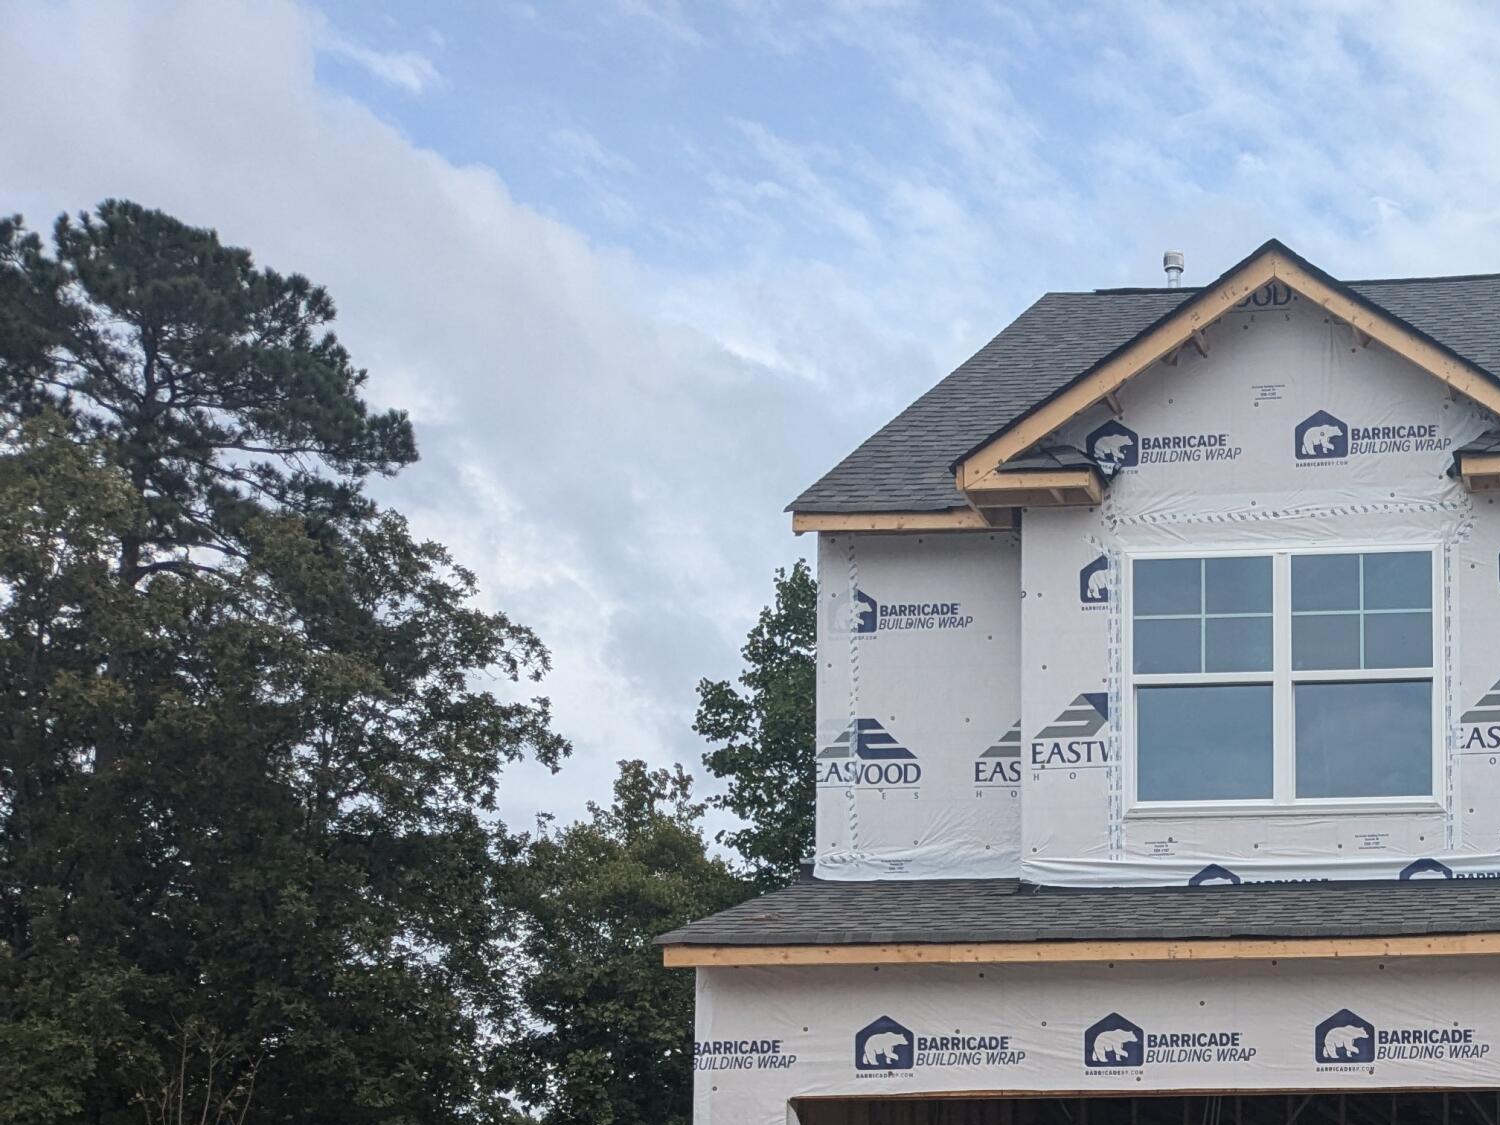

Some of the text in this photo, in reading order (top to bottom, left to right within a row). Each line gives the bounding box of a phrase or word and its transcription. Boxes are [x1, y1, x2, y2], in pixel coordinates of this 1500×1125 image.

[1351, 425, 1437, 441] BARRICADE
[1142, 434, 1227, 450] BARRICADE
[1350, 438, 1451, 455] BUILDING WRAP
[1141, 447, 1241, 464] BUILDING WRAP
[880, 603, 960, 617] BARRICADE
[879, 616, 973, 630] BUILDING WRAP
[917, 1036, 1011, 1052] BARRICADE
[1147, 1032, 1241, 1049] BARRICADE
[1378, 1029, 1474, 1045] BARRICADE
[915, 1051, 1026, 1067] BUILDING WRAP
[1146, 1047, 1257, 1064] BUILDING WRAP
[1377, 1044, 1490, 1060] BUILDING WRAP
[757, 1055, 797, 1068] WRAP
